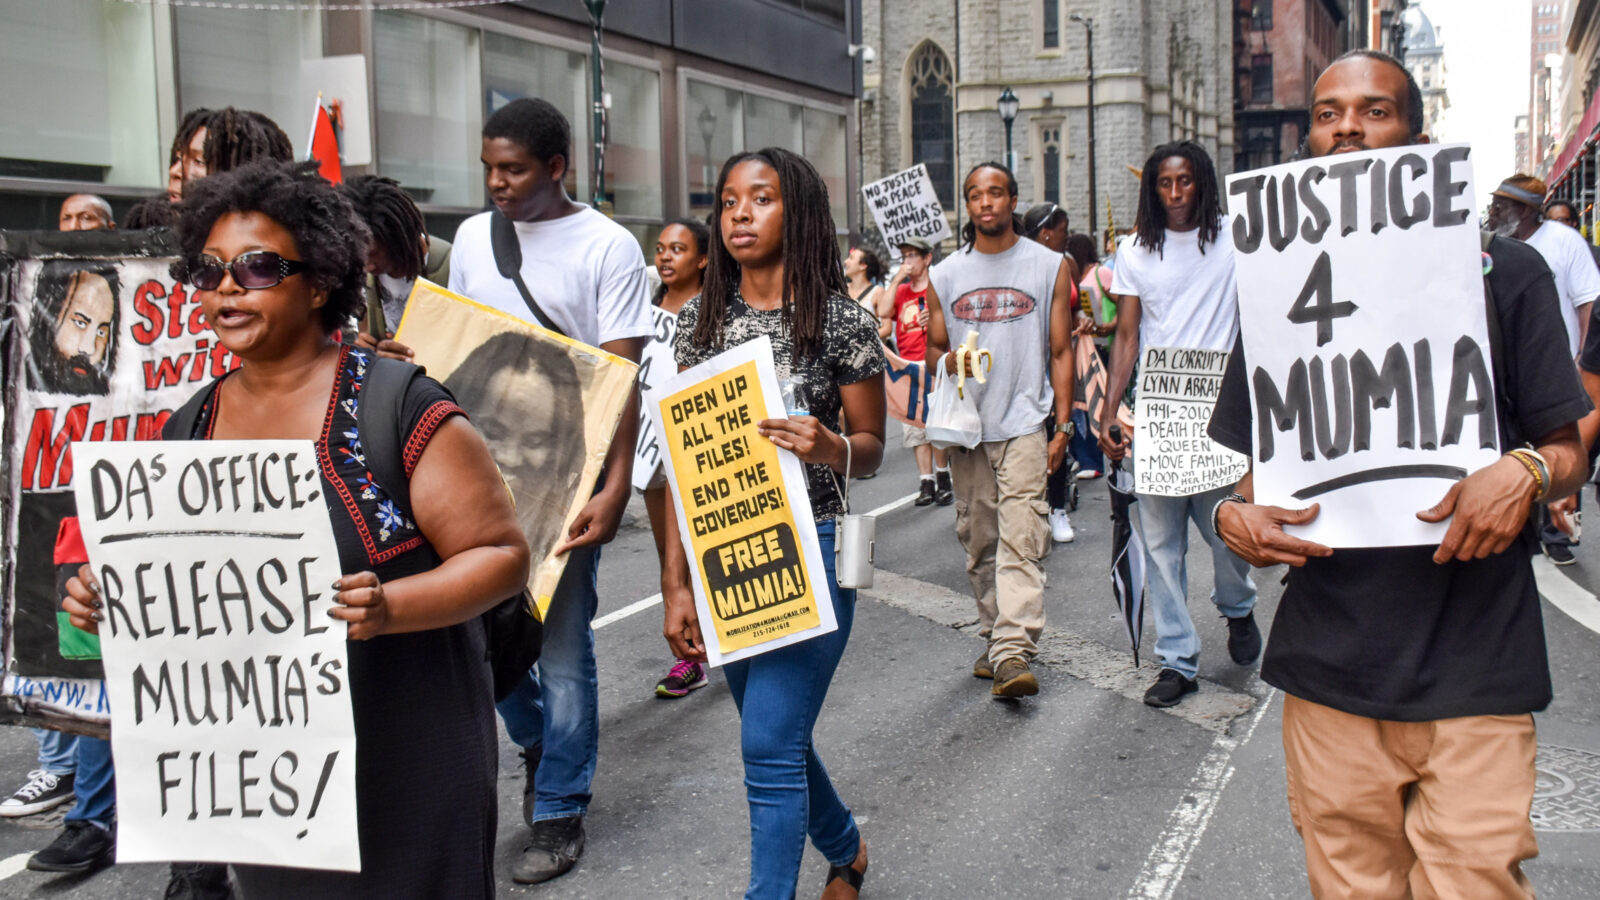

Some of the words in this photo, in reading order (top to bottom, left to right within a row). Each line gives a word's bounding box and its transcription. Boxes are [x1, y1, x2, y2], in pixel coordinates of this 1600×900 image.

[865, 185, 880, 199] NO
[882, 167, 924, 192] JUSTICE
[874, 196, 889, 210] NO
[890, 181, 922, 204] PEACE
[1229, 146, 1471, 254] JUSTICE
[883, 202, 941, 234] MUMIA'S
[884, 201, 917, 219] UNTIL
[1287, 250, 1359, 347] 4
[1146, 349, 1167, 369] DA
[670, 388, 718, 425] OPEN
[722, 375, 748, 398] UP
[1143, 375, 1180, 394] LYNN
[1252, 334, 1497, 463] MUMIA
[682, 422, 713, 450] ALL
[715, 404, 751, 435] THE
[1146, 403, 1211, 420] 1991-2010
[695, 435, 751, 474] FILES!
[1141, 471, 1179, 484] BLOOD
[1202, 460, 1245, 482] HANDS
[1190, 453, 1234, 469] FAMILY
[178, 452, 320, 516] OFFICE:
[692, 477, 730, 508] END
[733, 461, 770, 491] THE
[692, 487, 785, 537] COVERUPS!
[718, 529, 784, 577] FREE
[101, 557, 328, 641] RELEASE
[714, 564, 806, 618] MUMIA!
[156, 750, 340, 839] FILES!
